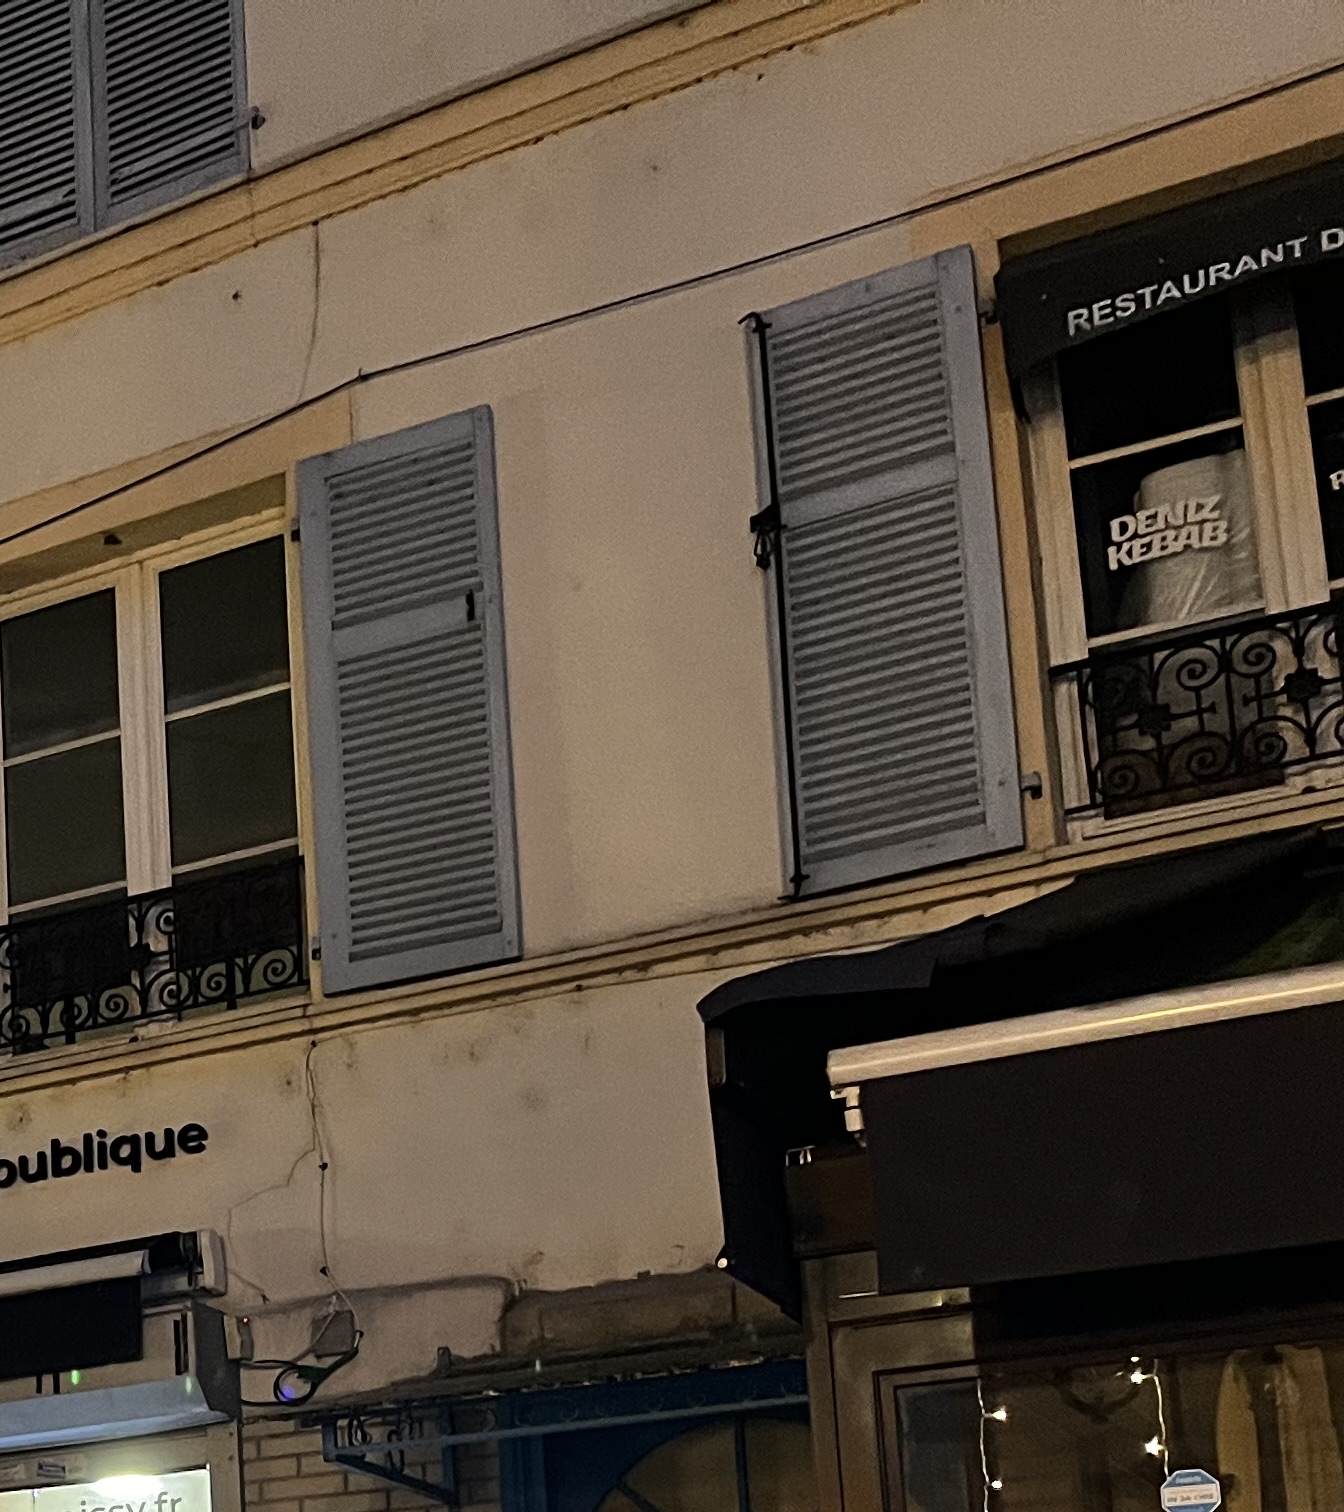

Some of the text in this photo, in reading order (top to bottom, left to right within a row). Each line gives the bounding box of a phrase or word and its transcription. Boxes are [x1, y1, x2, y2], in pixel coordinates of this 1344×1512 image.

[1067, 235, 1308, 337] RESTAURANT
[1110, 494, 1223, 543] DENIZ
[1107, 520, 1228, 571] KEBAB
